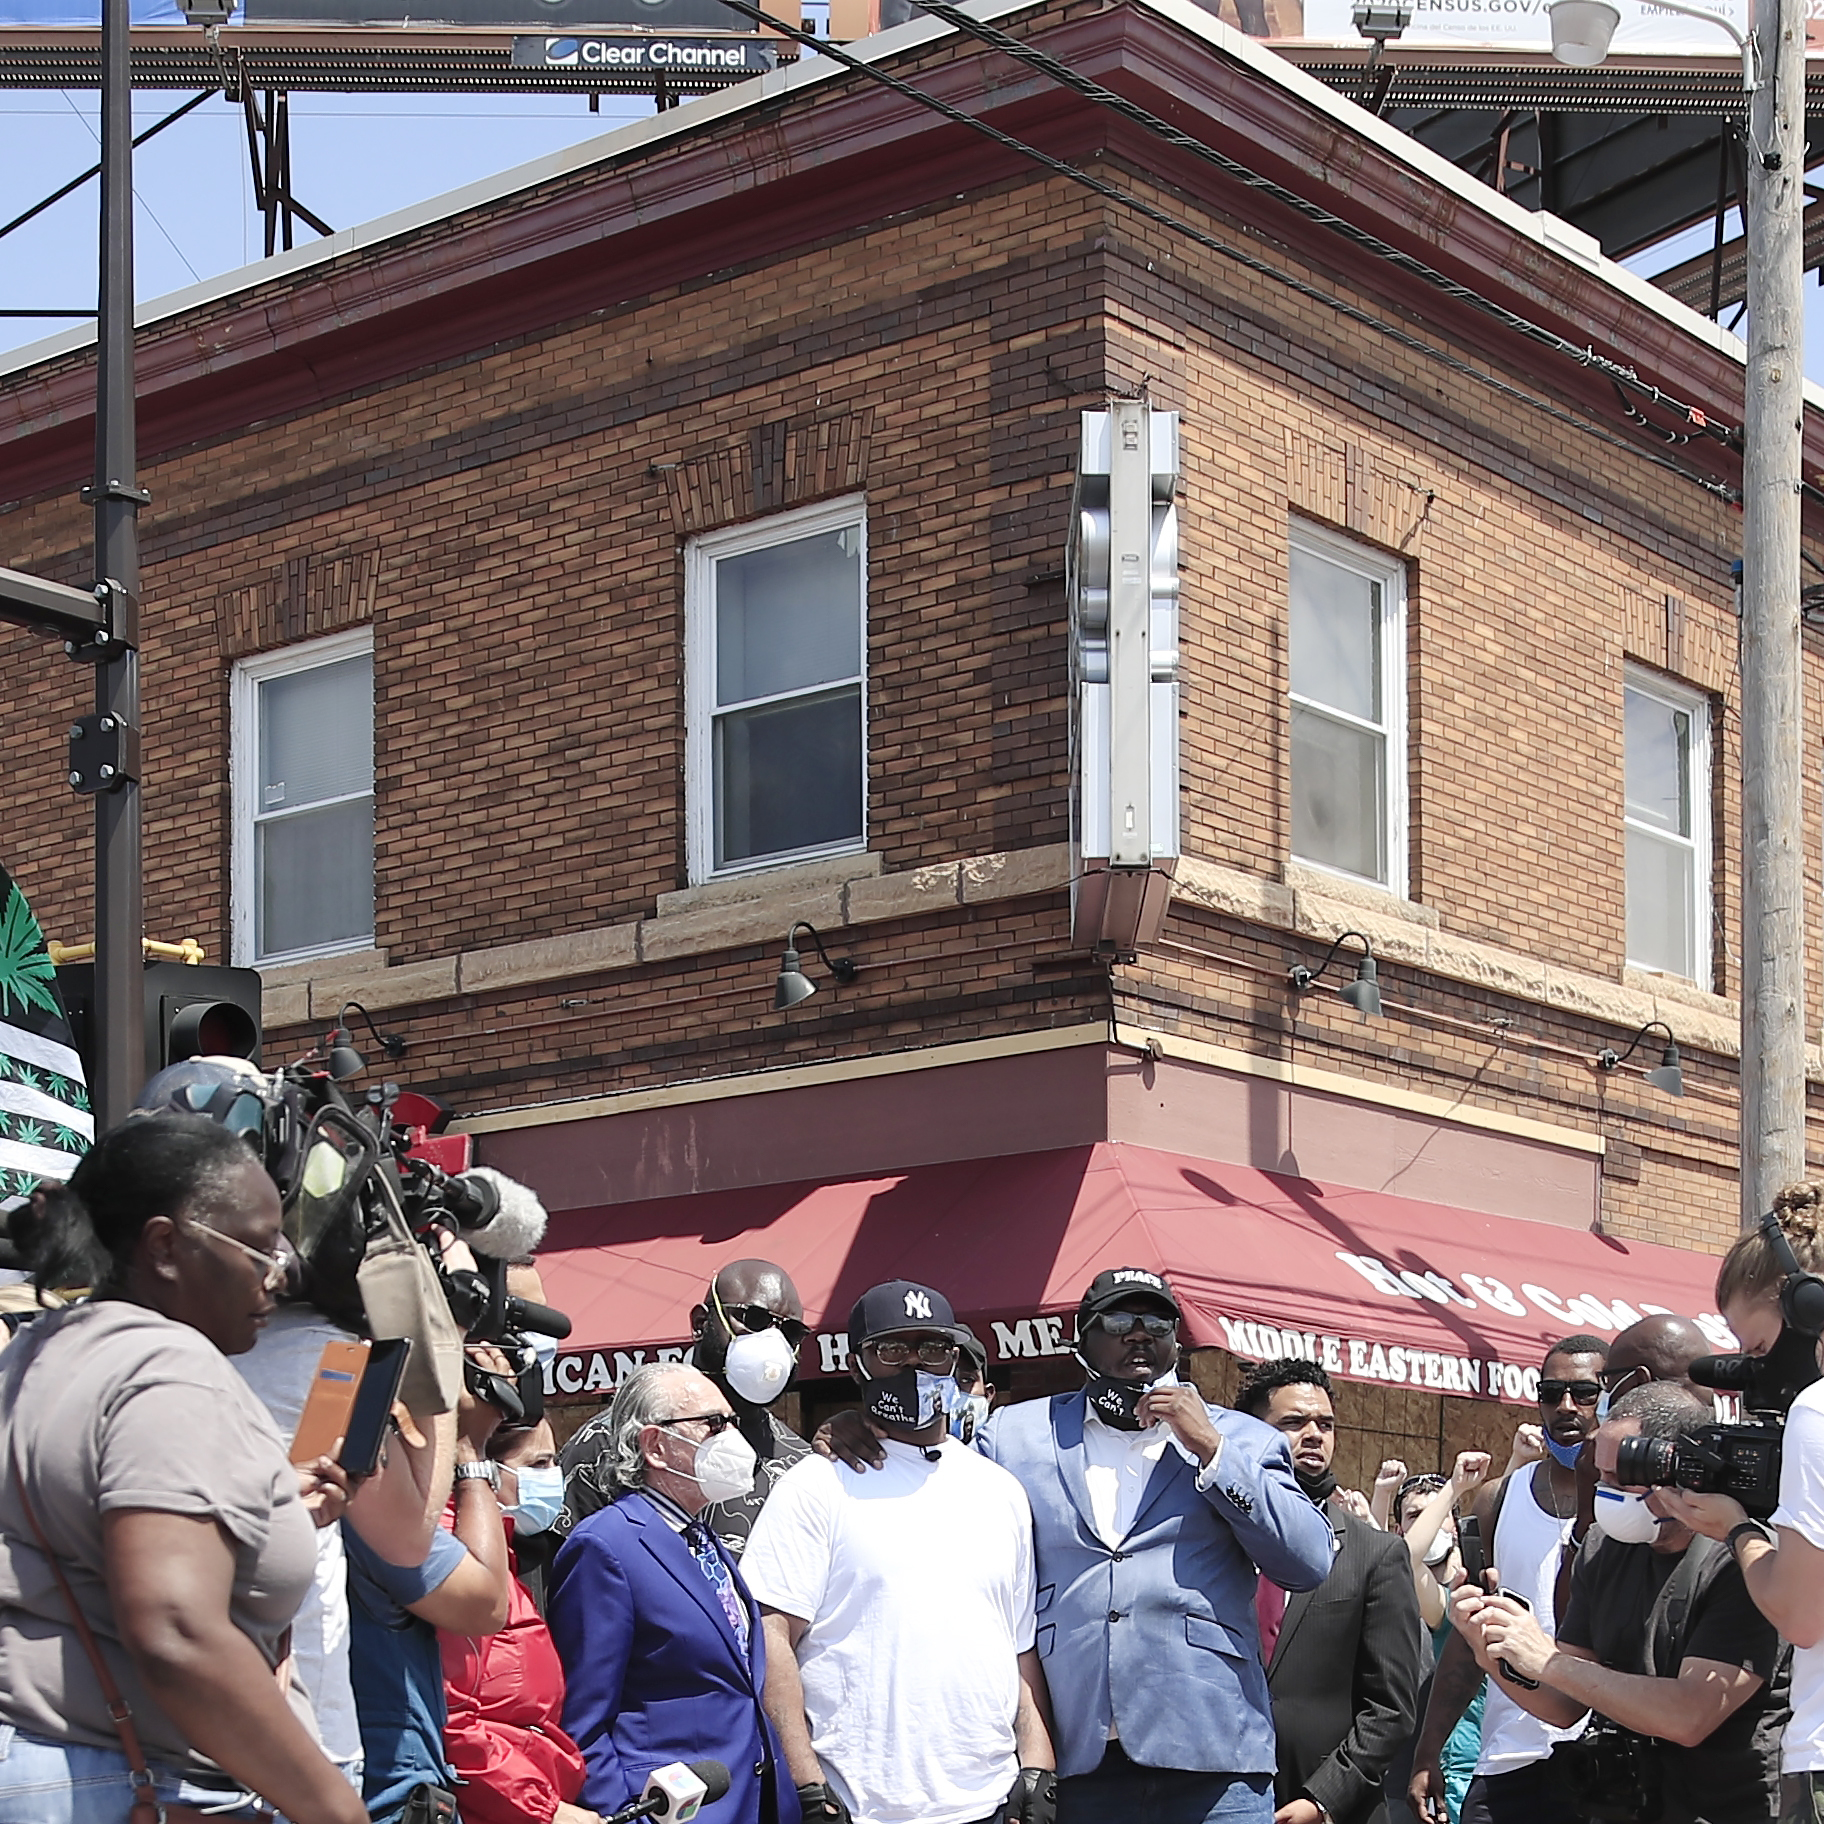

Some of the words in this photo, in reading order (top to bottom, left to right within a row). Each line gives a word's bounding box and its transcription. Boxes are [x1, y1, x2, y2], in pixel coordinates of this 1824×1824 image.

[582, 41, 645, 65] Clear
[649, 41, 746, 66] Channel
[1335, 1252, 1477, 1308] Hot
[1218, 1316, 1344, 1373] MIDDLE
[1348, 1339, 1481, 1394] EASTERN
[1487, 1359, 1540, 1403] FOO
[878, 1400, 904, 1414] Can't
[881, 1390, 900, 1404] We
[1107, 1388, 1124, 1406] We
